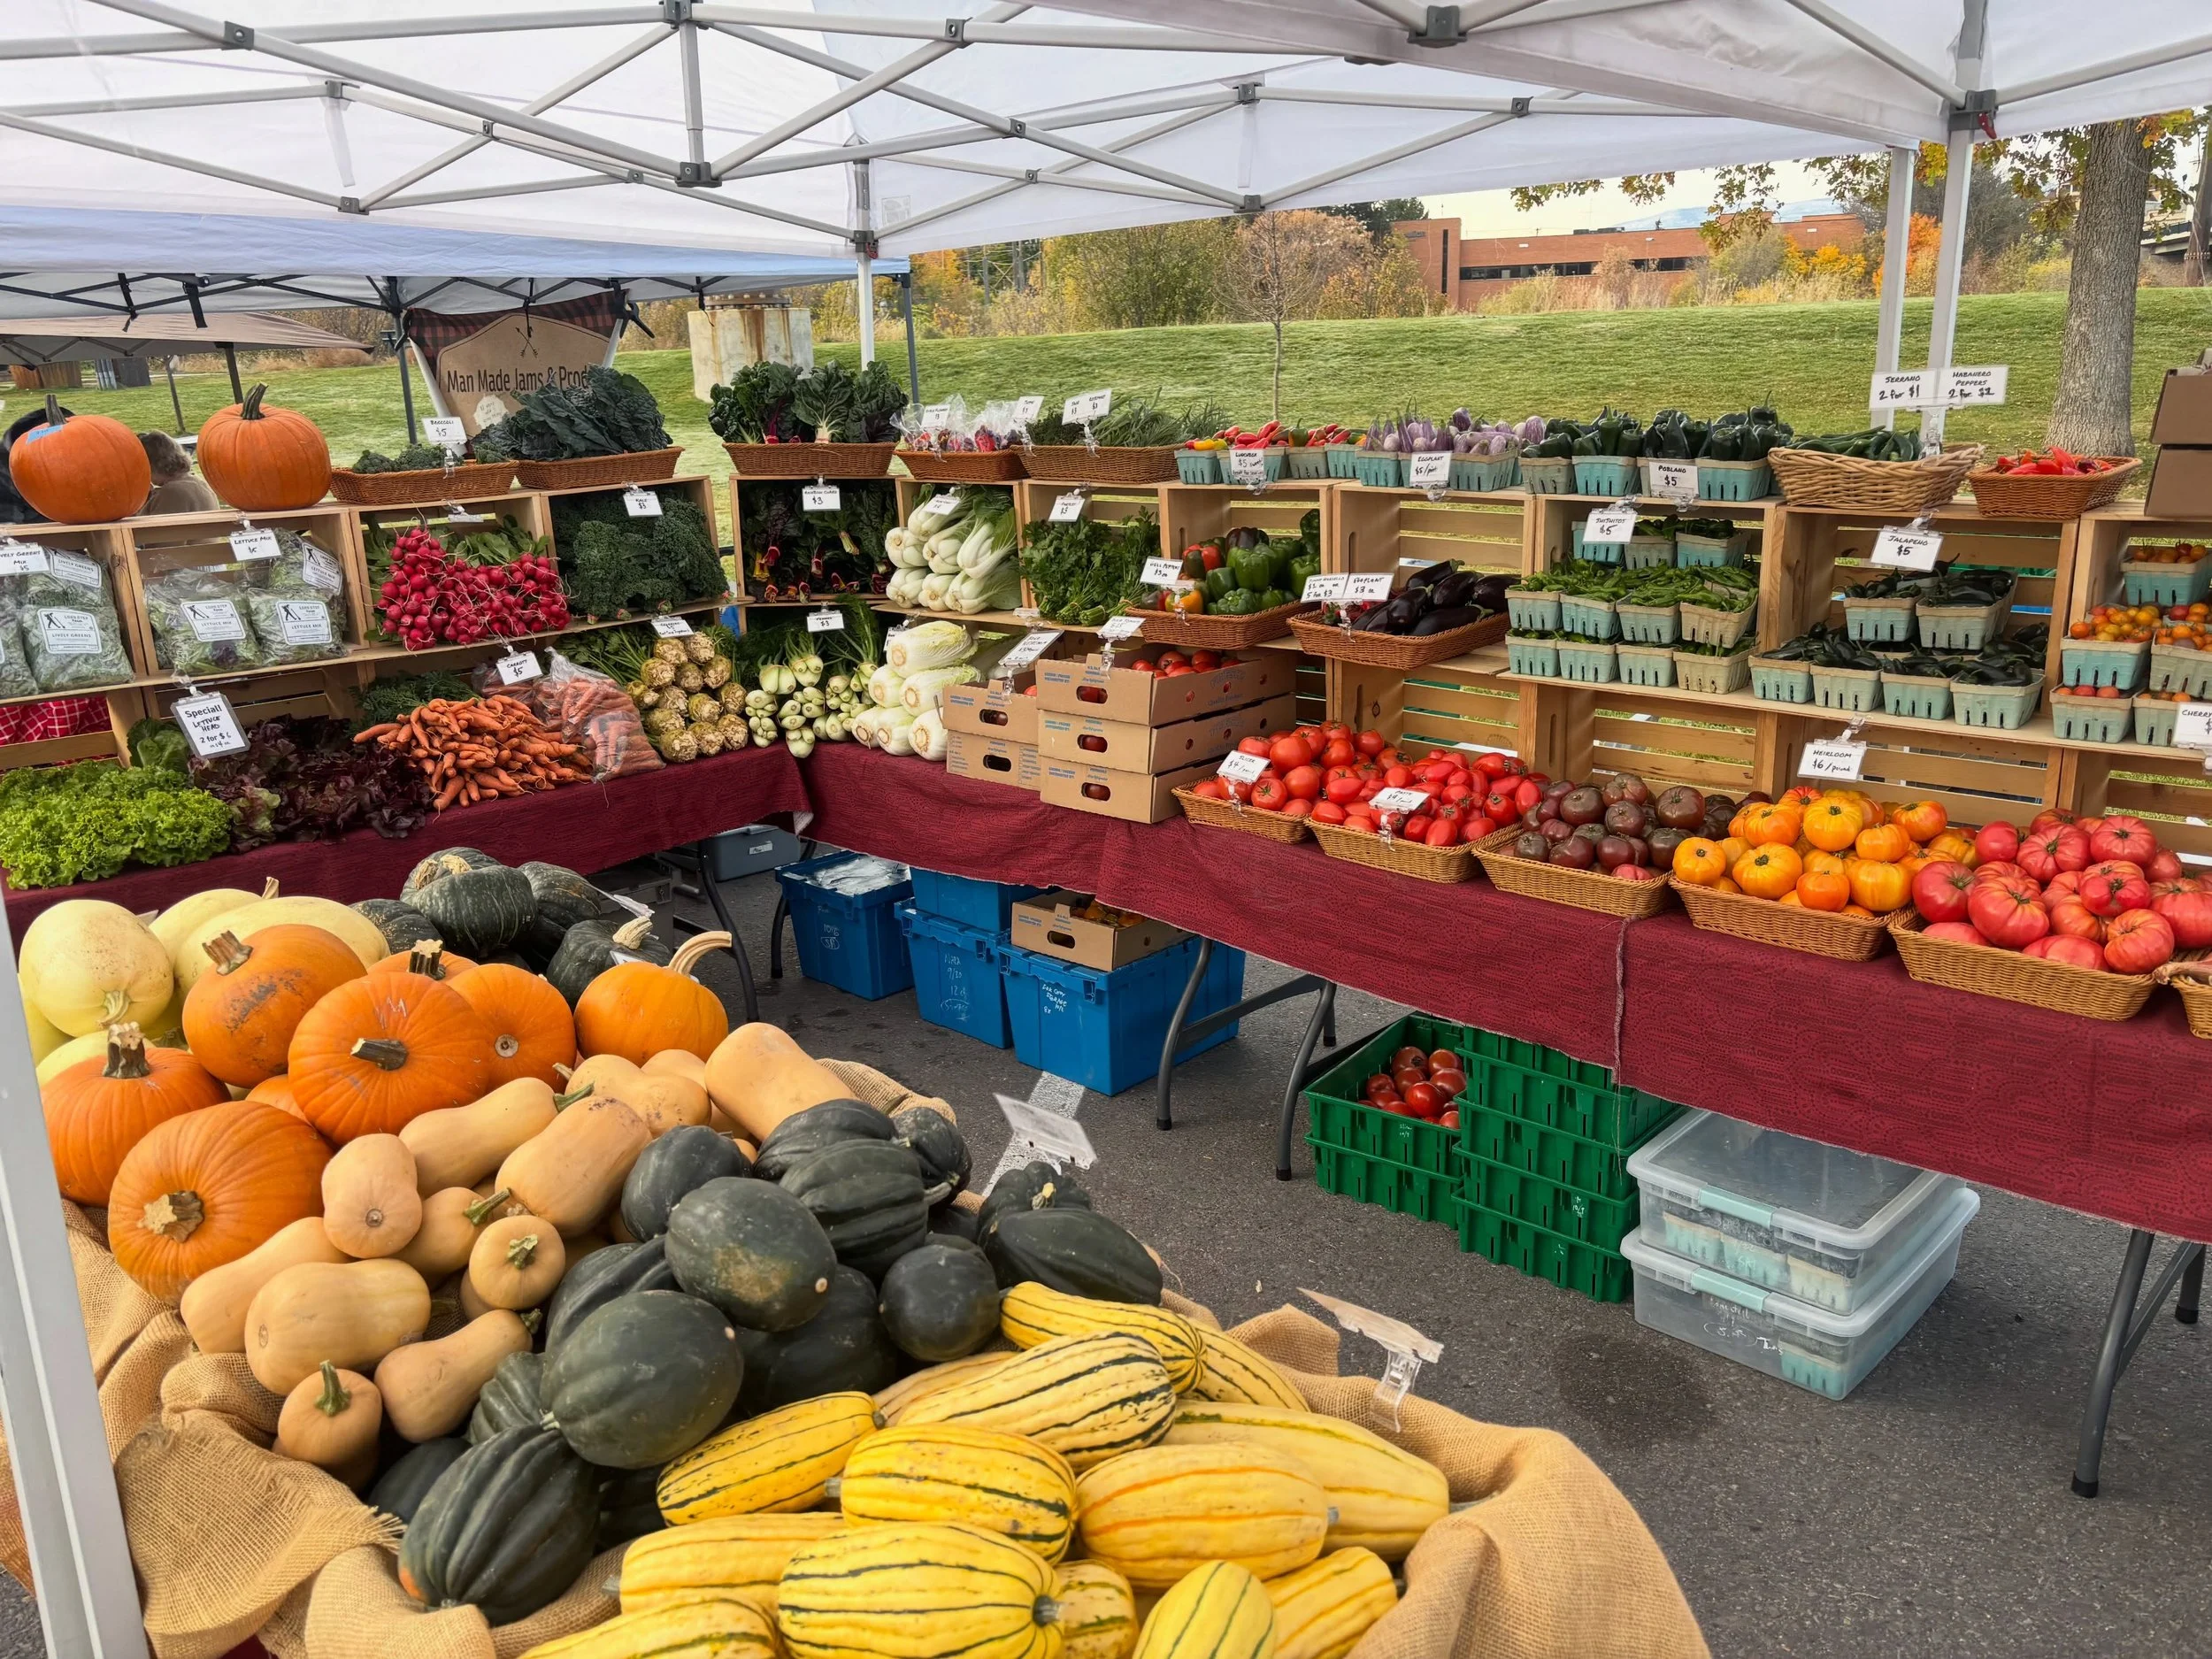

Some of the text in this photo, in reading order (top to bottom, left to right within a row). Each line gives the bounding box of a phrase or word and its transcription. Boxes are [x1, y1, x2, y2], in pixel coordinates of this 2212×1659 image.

[447, 370, 474, 393] Man
[478, 368, 511, 392] Made
[515, 367, 543, 391] Jams
[547, 366, 557, 386] &
[1878, 384, 1920, 400] 2 for $1
[1947, 388, 1958, 399] 2
[1960, 388, 1972, 397] for
[436, 426, 447, 436] $5
[1239, 458, 1248, 468] $5
[1664, 474, 1678, 487] $5
[812, 495, 824, 505] $3
[1600, 524, 1618, 535] $5
[1887, 535, 1928, 546] JALAPENO
[1897, 544, 1914, 557] $5
[74, 562, 94, 572] GREENS
[513, 666, 524, 678] $5
[184, 704, 223, 719] Special!
[2181, 709, 2212, 718] CHERRY
[192, 715, 221, 729] LETTUCE
[200, 723, 220, 733] HEAD
[1812, 749, 1852, 758] HEIRLOOM
